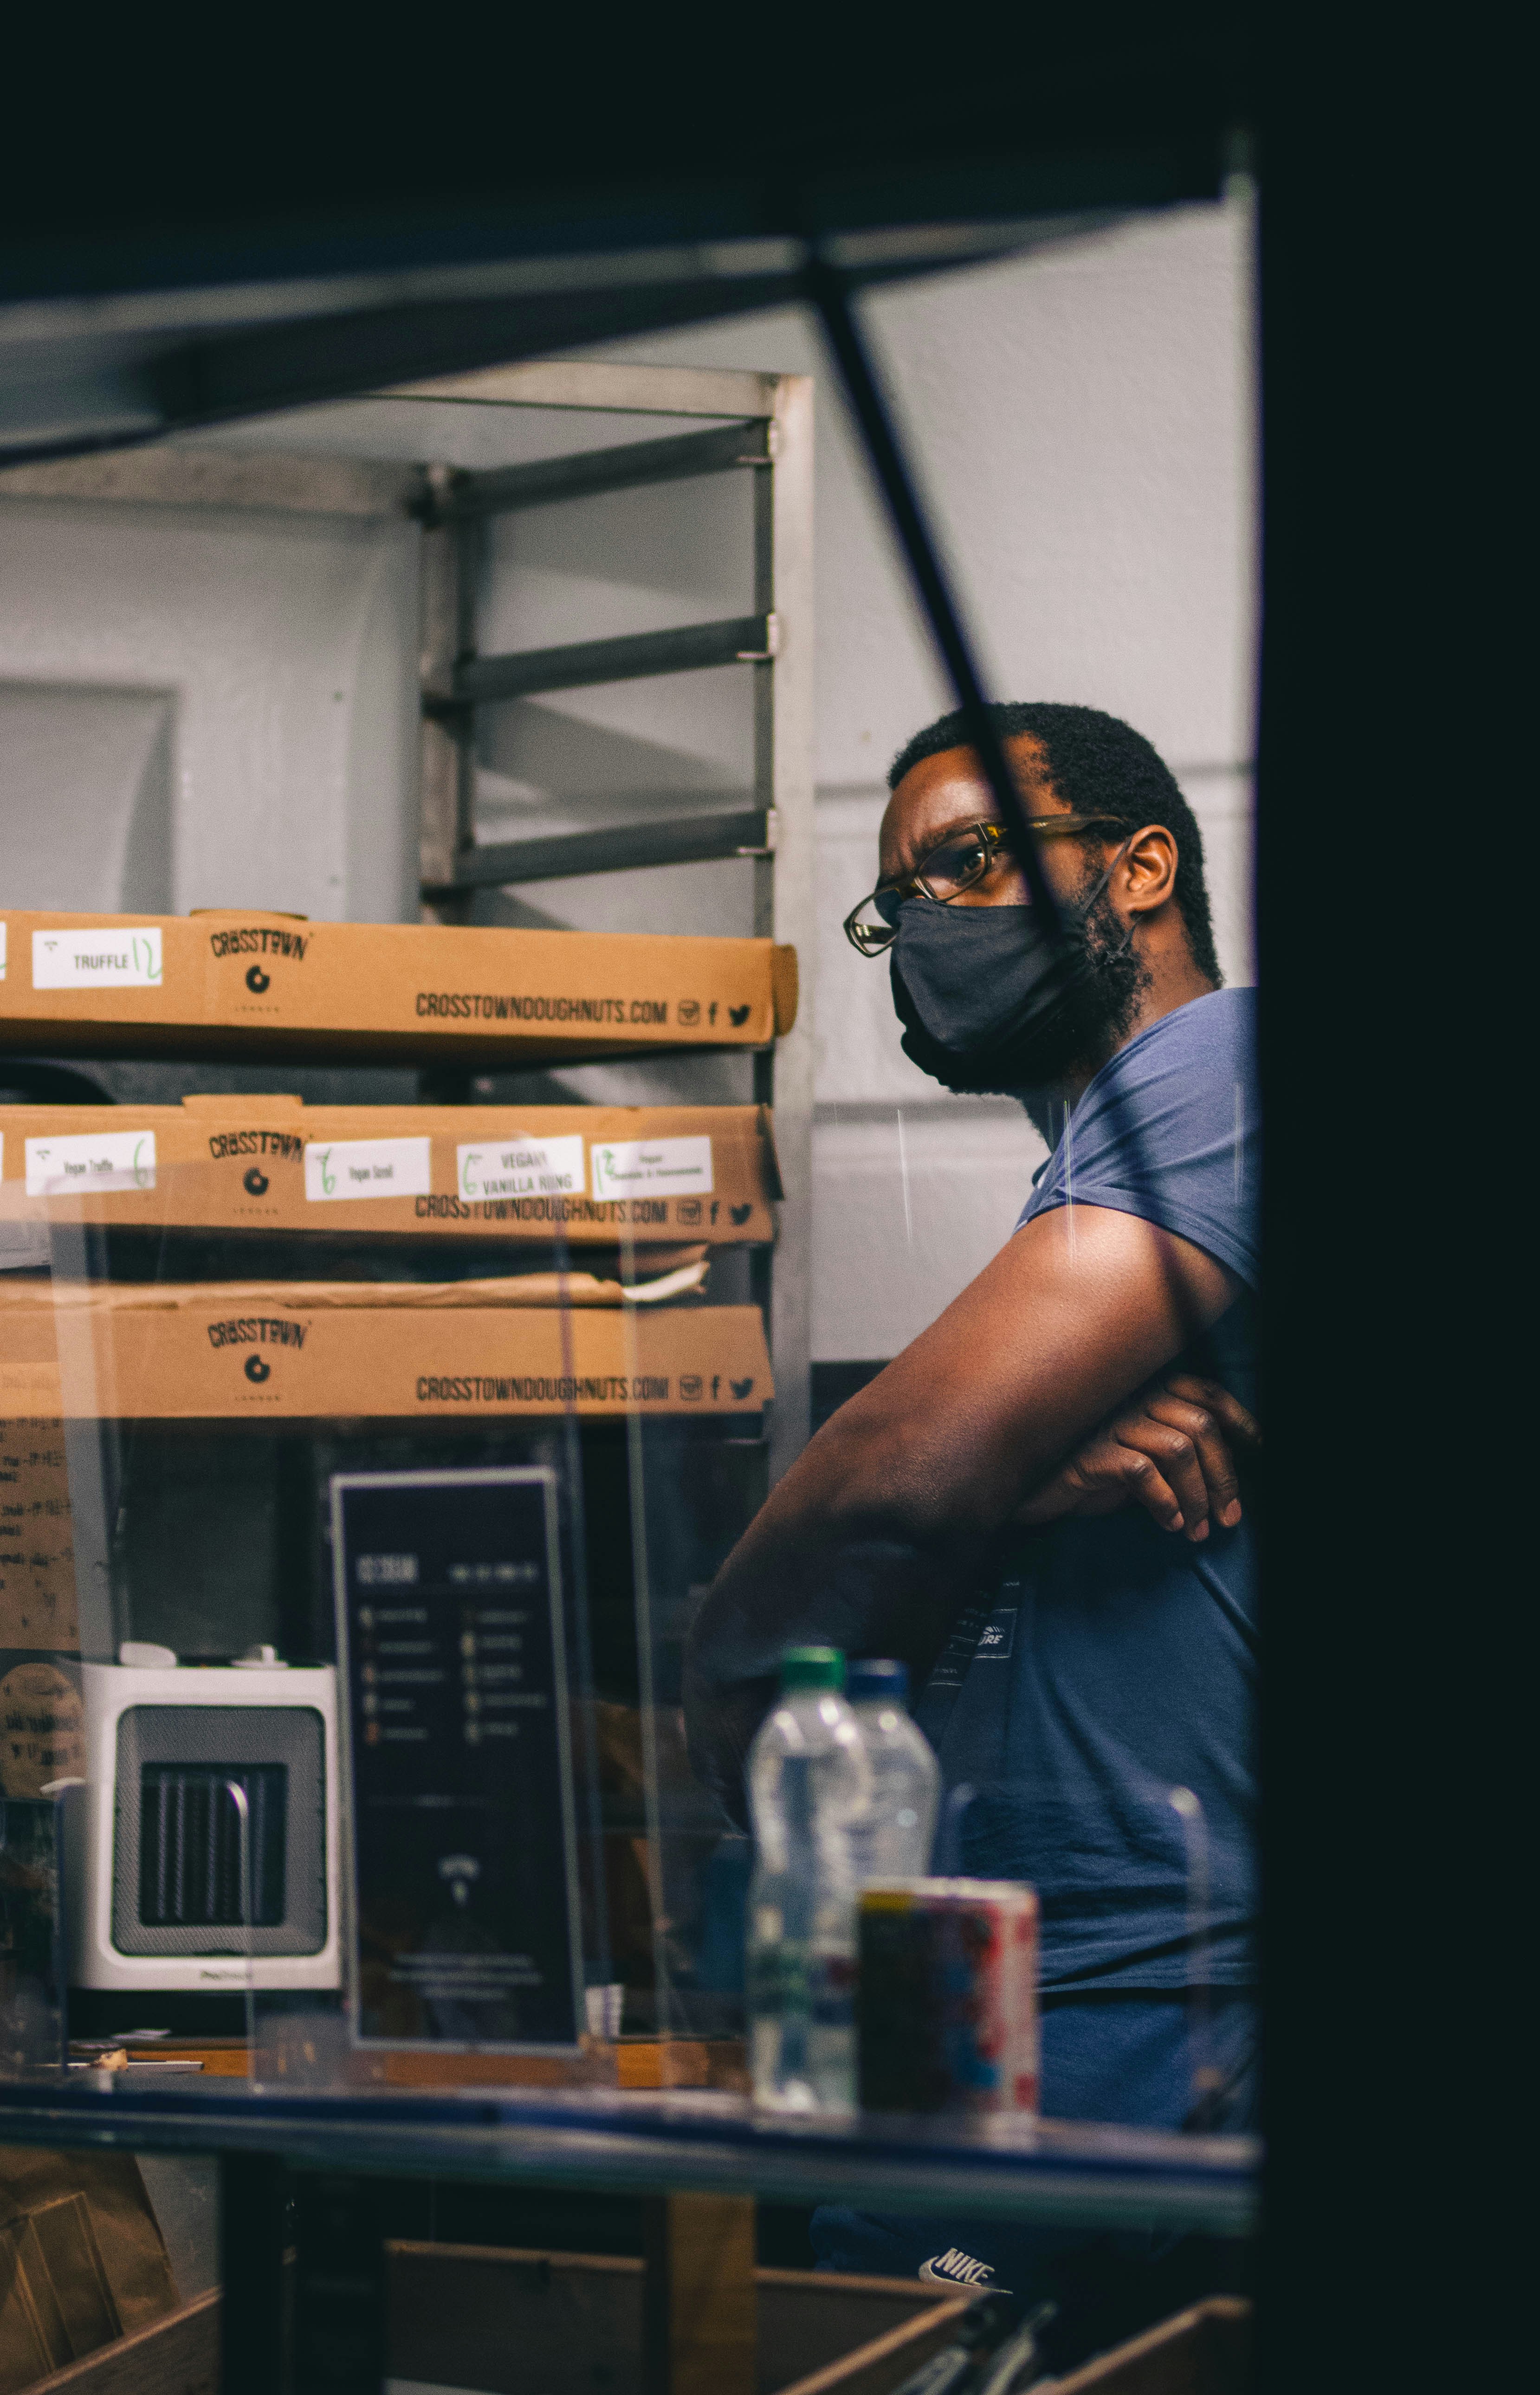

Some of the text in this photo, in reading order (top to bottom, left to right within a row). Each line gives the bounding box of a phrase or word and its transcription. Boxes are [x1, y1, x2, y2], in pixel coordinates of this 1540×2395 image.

[210, 929, 308, 961] CROSSTOWN
[74, 954, 128, 970] TRUFFLE
[416, 992, 667, 1024] CROSSTOWNDOUGHNUTS.COM
[483, 1176, 534, 1196] VANILLA
[207, 1318, 308, 1350] CROSSTOWN
[416, 1375, 668, 1402] CROSSTOWNDOUGHNUTS.COM
[935, 2247, 995, 2286] NIKE
